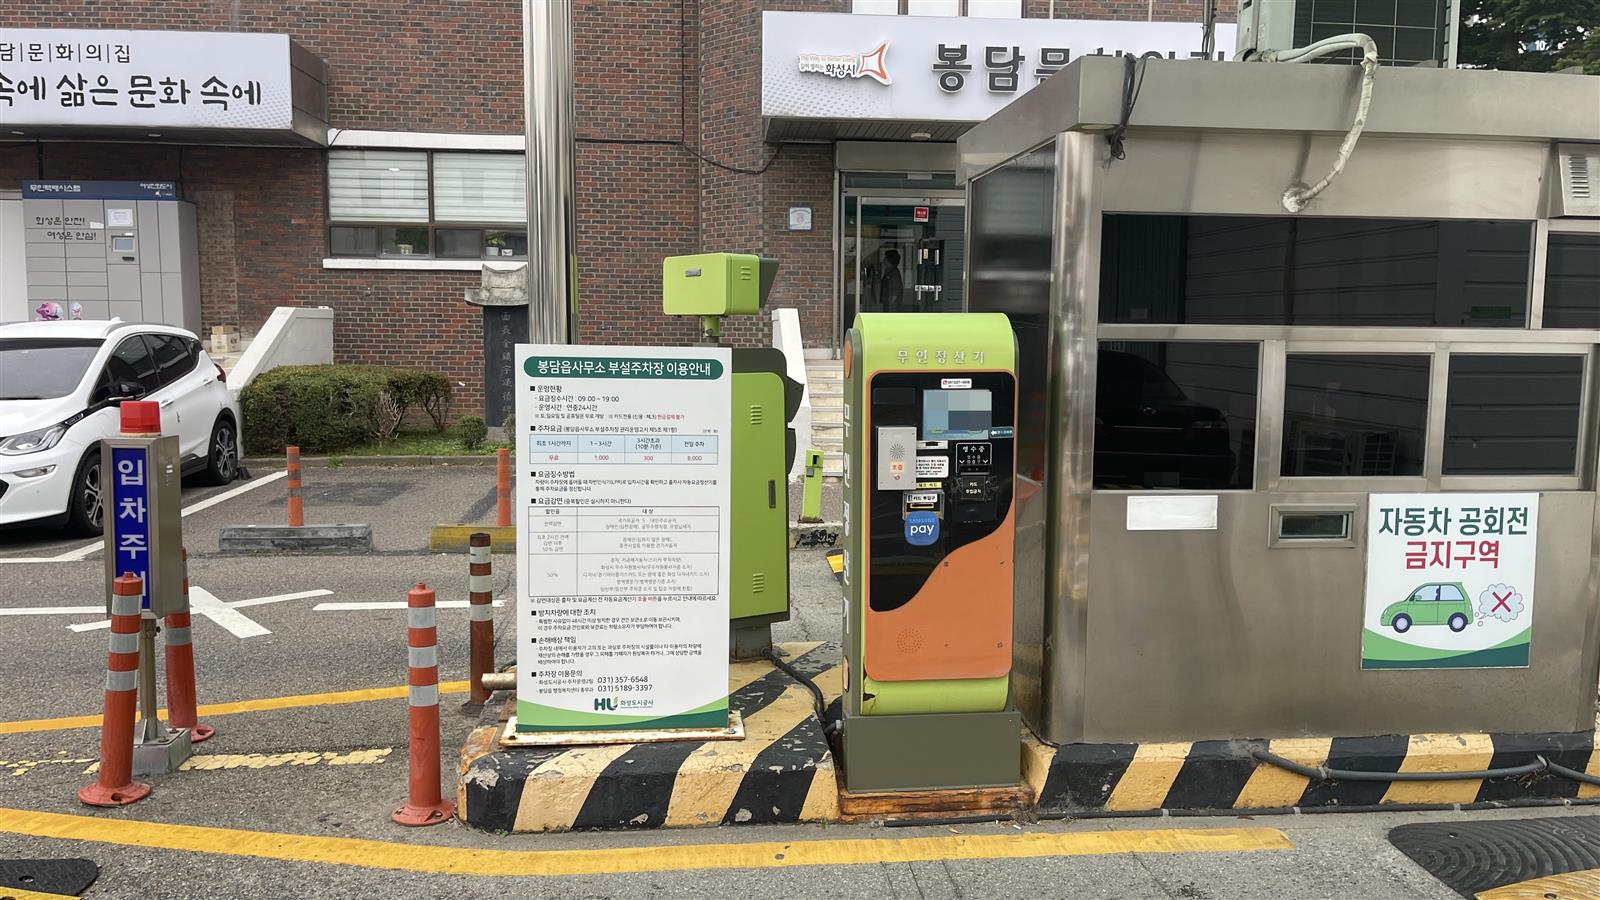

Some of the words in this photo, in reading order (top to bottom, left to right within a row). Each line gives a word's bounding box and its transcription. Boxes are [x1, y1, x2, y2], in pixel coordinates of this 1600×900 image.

[826, 64, 855, 76] 화성시
[56, 72, 119, 107] 삶은
[127, 75, 191, 108] 문화
[200, 75, 261, 111] 속에
[36, 217, 61, 225] 화성은
[64, 217, 85, 225] 안전!
[47, 231, 73, 240] 여성은
[76, 232, 96, 240] 안심!
[897, 350, 984, 364] 무인정산기
[537, 361, 606, 374] 봉담읍사무소
[608, 361, 664, 375] 부설주차장
[667, 362, 711, 376] 이용안내
[538, 385, 562, 393] 운영현황
[1378, 506, 1452, 536] 자동차
[1459, 506, 1529, 536] 공회전
[910, 525, 934, 536] pay
[1405, 540, 1500, 570] 금지구역
[570, 608, 582, 616] 대한
[583, 608, 596, 616] 조치
[564, 636, 577, 644] 책임
